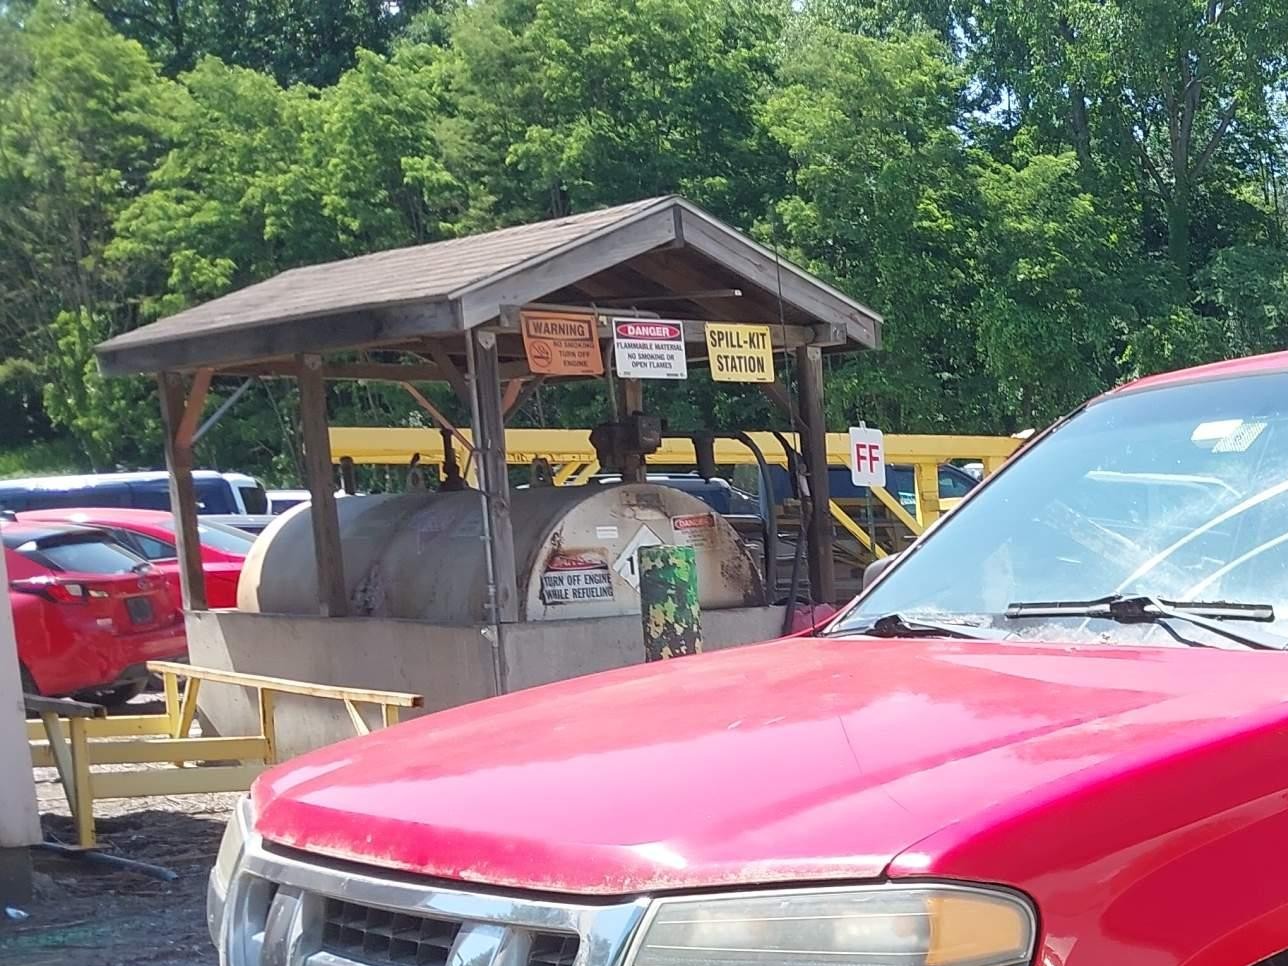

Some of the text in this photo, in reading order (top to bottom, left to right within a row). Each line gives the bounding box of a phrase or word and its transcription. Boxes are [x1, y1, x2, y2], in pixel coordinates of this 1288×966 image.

[532, 322, 585, 336] WARNING
[627, 325, 670, 337] DANGER
[616, 341, 683, 351] FLAMMABLE MATERIAL
[709, 330, 767, 349] SPILL-KIT
[716, 354, 765, 373] STATION
[855, 443, 880, 473] FF
[543, 573, 612, 587] TURN OFF ENGINE
[545, 586, 614, 600] WHILE REFUELING
